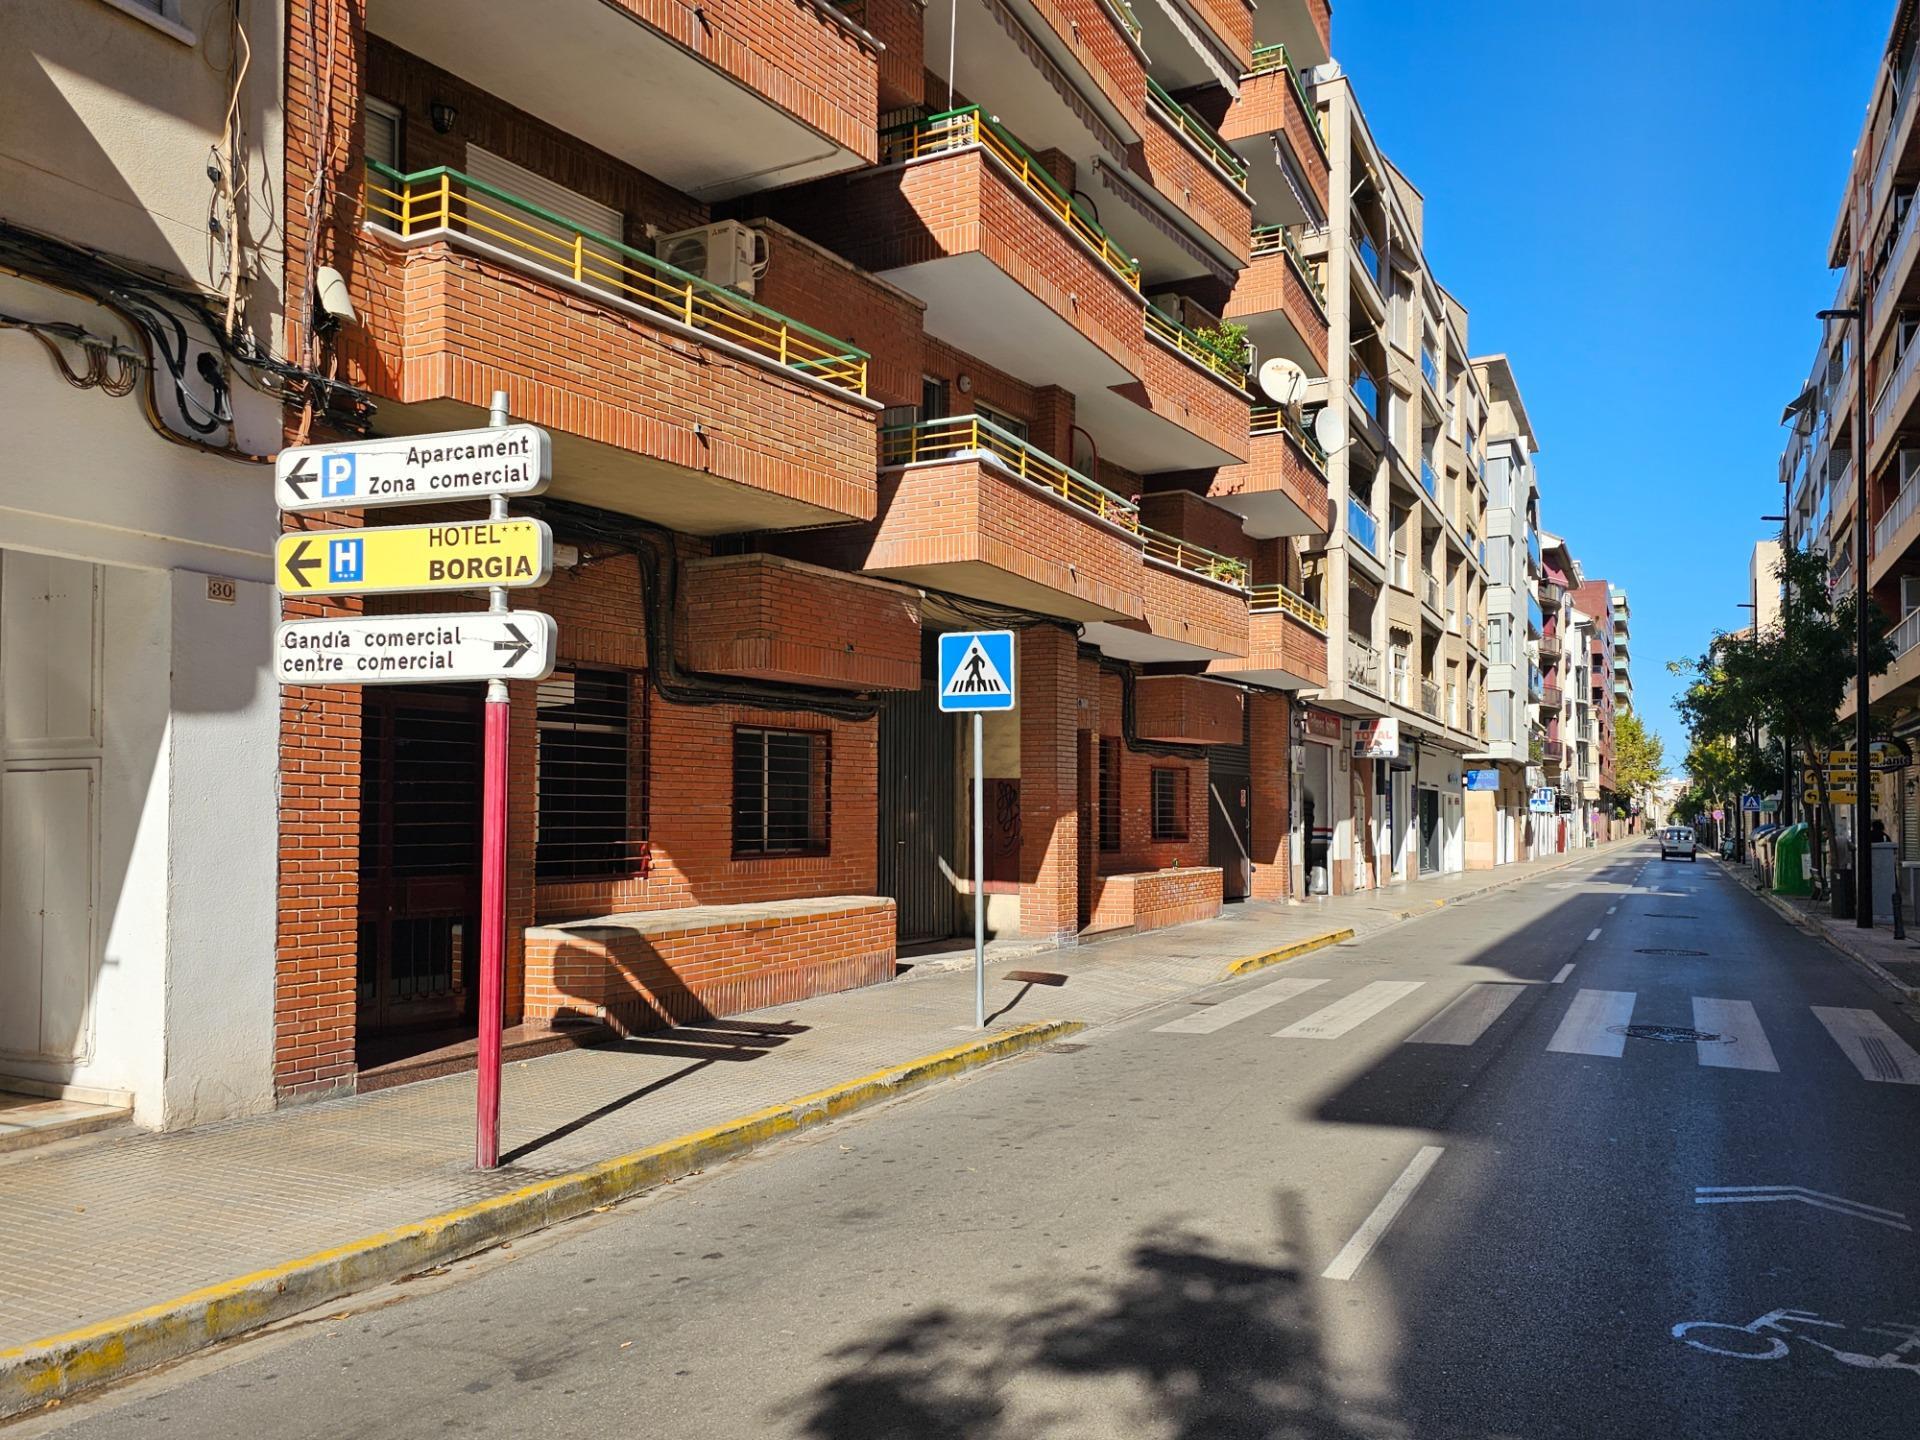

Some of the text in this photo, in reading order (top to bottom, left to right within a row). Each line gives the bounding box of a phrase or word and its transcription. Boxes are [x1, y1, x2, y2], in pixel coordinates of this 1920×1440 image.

[407, 435, 529, 468] Aparcament
[328, 458, 352, 494] P
[369, 463, 529, 495] Zona comercial
[335, 541, 357, 573] H
[429, 555, 533, 581] BORGIA
[212, 582, 232, 598] 30
[364, 627, 462, 647] comercial
[283, 651, 454, 672] centre comercial
[1354, 731, 1393, 740] TOTAL
